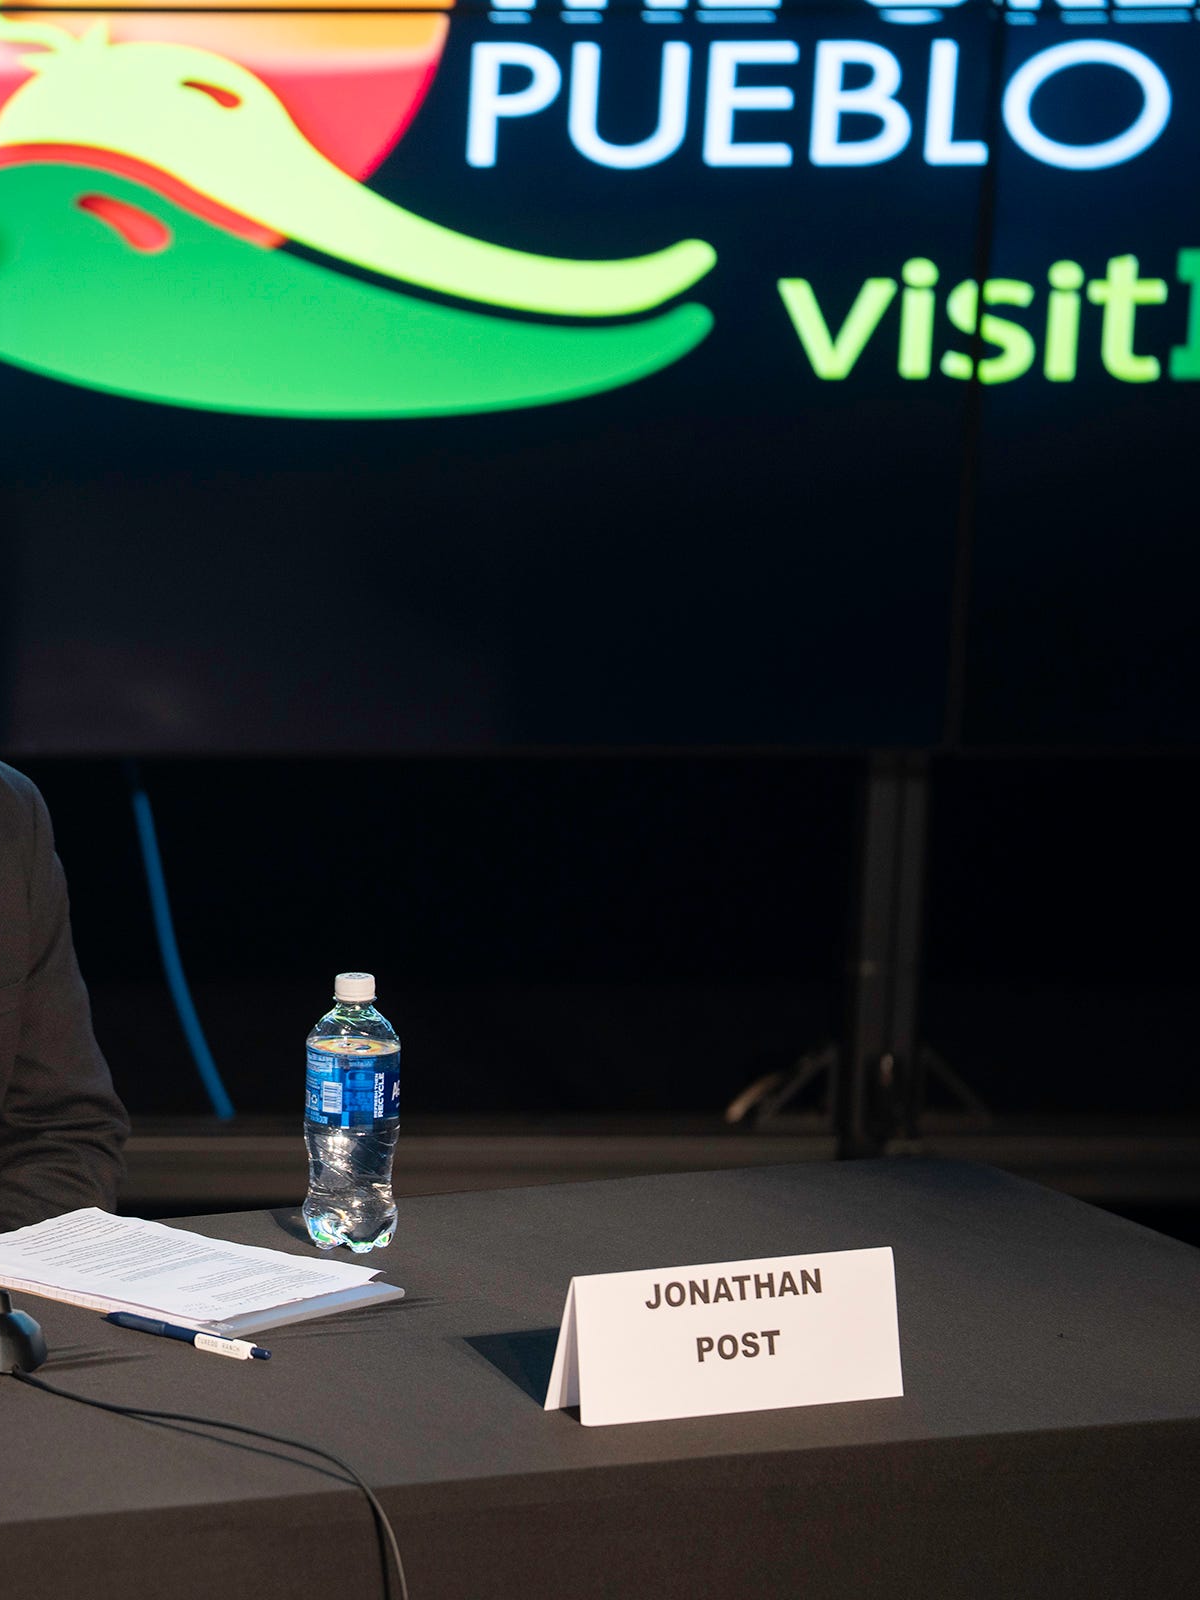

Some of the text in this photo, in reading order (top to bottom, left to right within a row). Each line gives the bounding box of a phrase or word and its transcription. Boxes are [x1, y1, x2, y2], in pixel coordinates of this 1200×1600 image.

[466, 39, 1171, 169] PUEBLO
[645, 1268, 822, 1310] JONATHAN
[696, 1330, 780, 1362] POST
